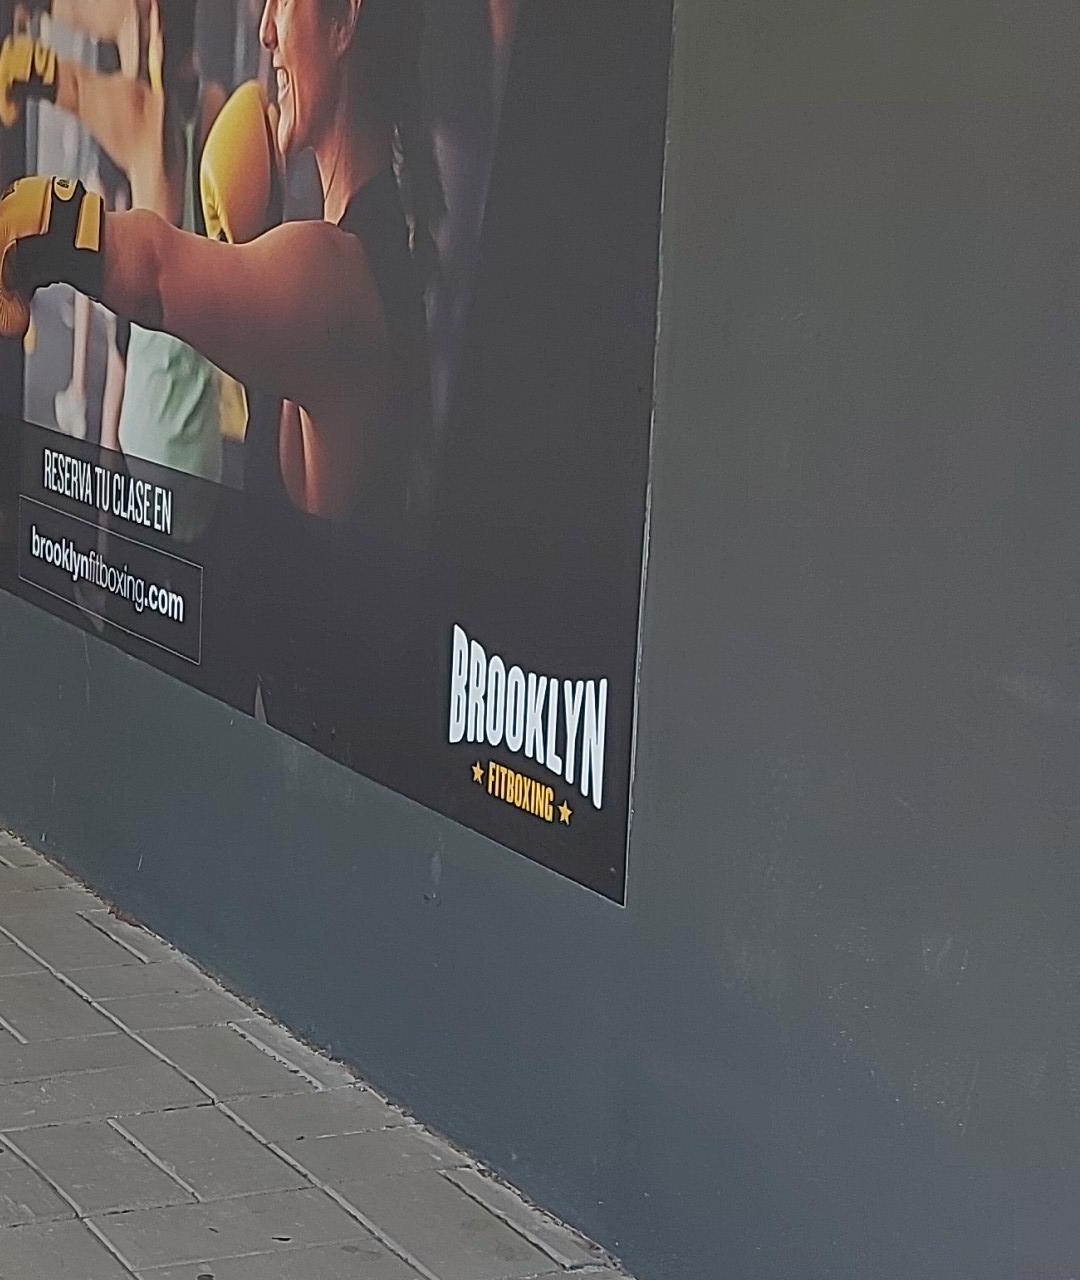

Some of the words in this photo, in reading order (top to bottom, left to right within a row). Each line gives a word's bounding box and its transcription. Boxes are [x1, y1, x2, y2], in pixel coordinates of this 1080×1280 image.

[43, 448, 93, 506] RESERVA
[94, 466, 111, 513] TU
[112, 474, 152, 527] CLASE
[153, 485, 173, 535] EN
[30, 524, 185, 623] brooklynfitboxing.com
[448, 623, 609, 810] BROOKLYN
[486, 761, 555, 822] FITBOXING
